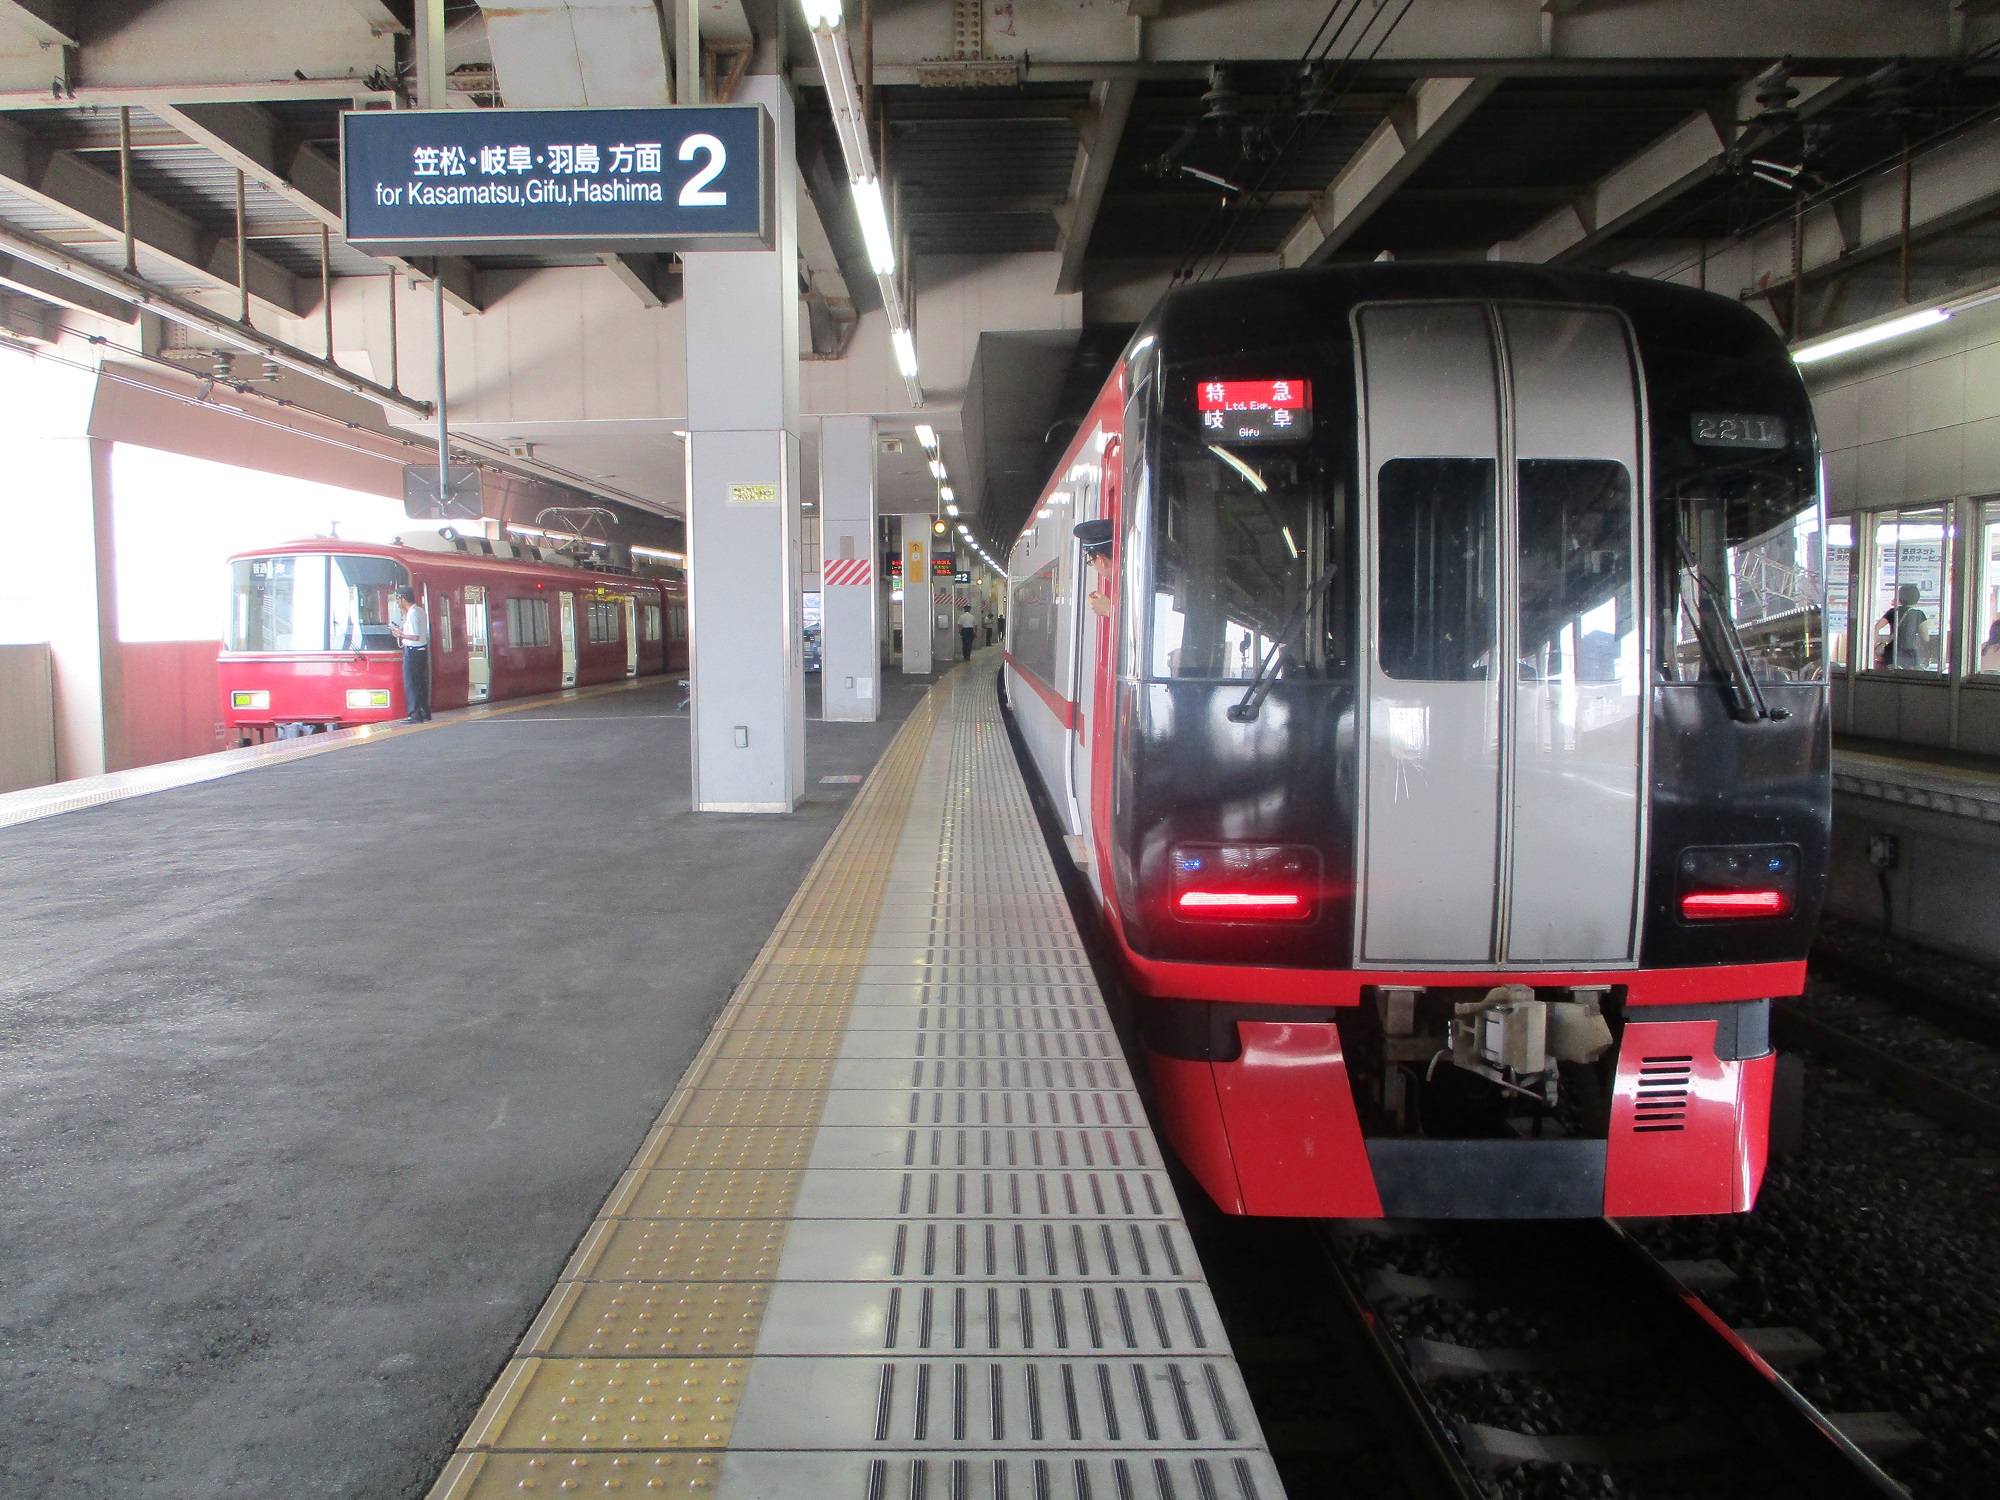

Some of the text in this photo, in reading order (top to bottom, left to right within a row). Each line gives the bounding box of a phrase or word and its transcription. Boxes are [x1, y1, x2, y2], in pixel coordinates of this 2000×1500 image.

[413, 143, 662, 176] 笠松・岐阜・羽島 方面
[678, 133, 727, 206] 2
[375, 178, 662, 207] for Kasamatsu,Gifu,Hashima
[1206, 382, 1291, 402] 特急
[1225, 401, 1248, 411] Ltd.
[1205, 409, 1291, 429] 岐阜
[1239, 427, 1260, 438] Gifu
[1698, 419, 1768, 441] 2211
[961, 573, 968, 582] 2
